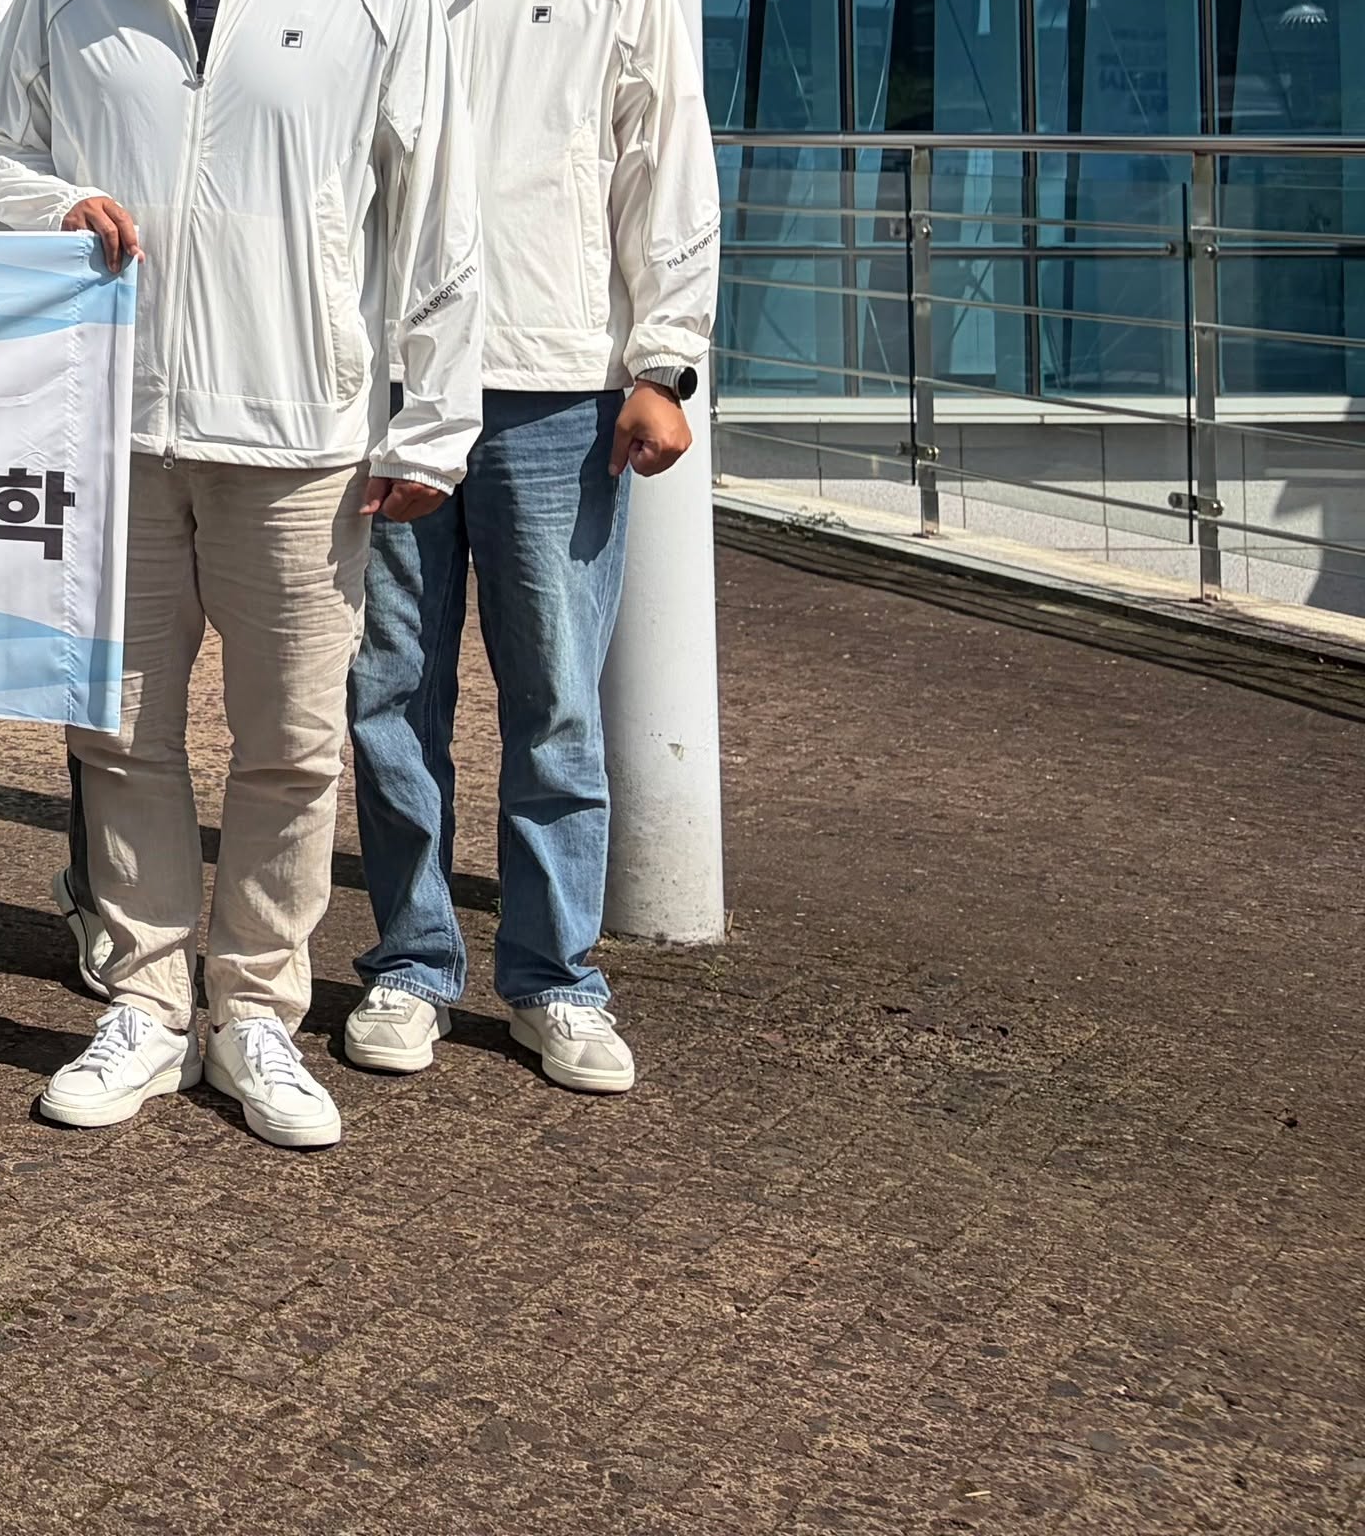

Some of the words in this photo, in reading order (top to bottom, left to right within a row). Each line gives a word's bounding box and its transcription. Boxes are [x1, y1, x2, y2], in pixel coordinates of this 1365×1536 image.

[666, 248, 689, 269] FILA
[688, 233, 713, 257] SPORT
[411, 307, 432, 326] FILA
[429, 280, 459, 309] SPORT
